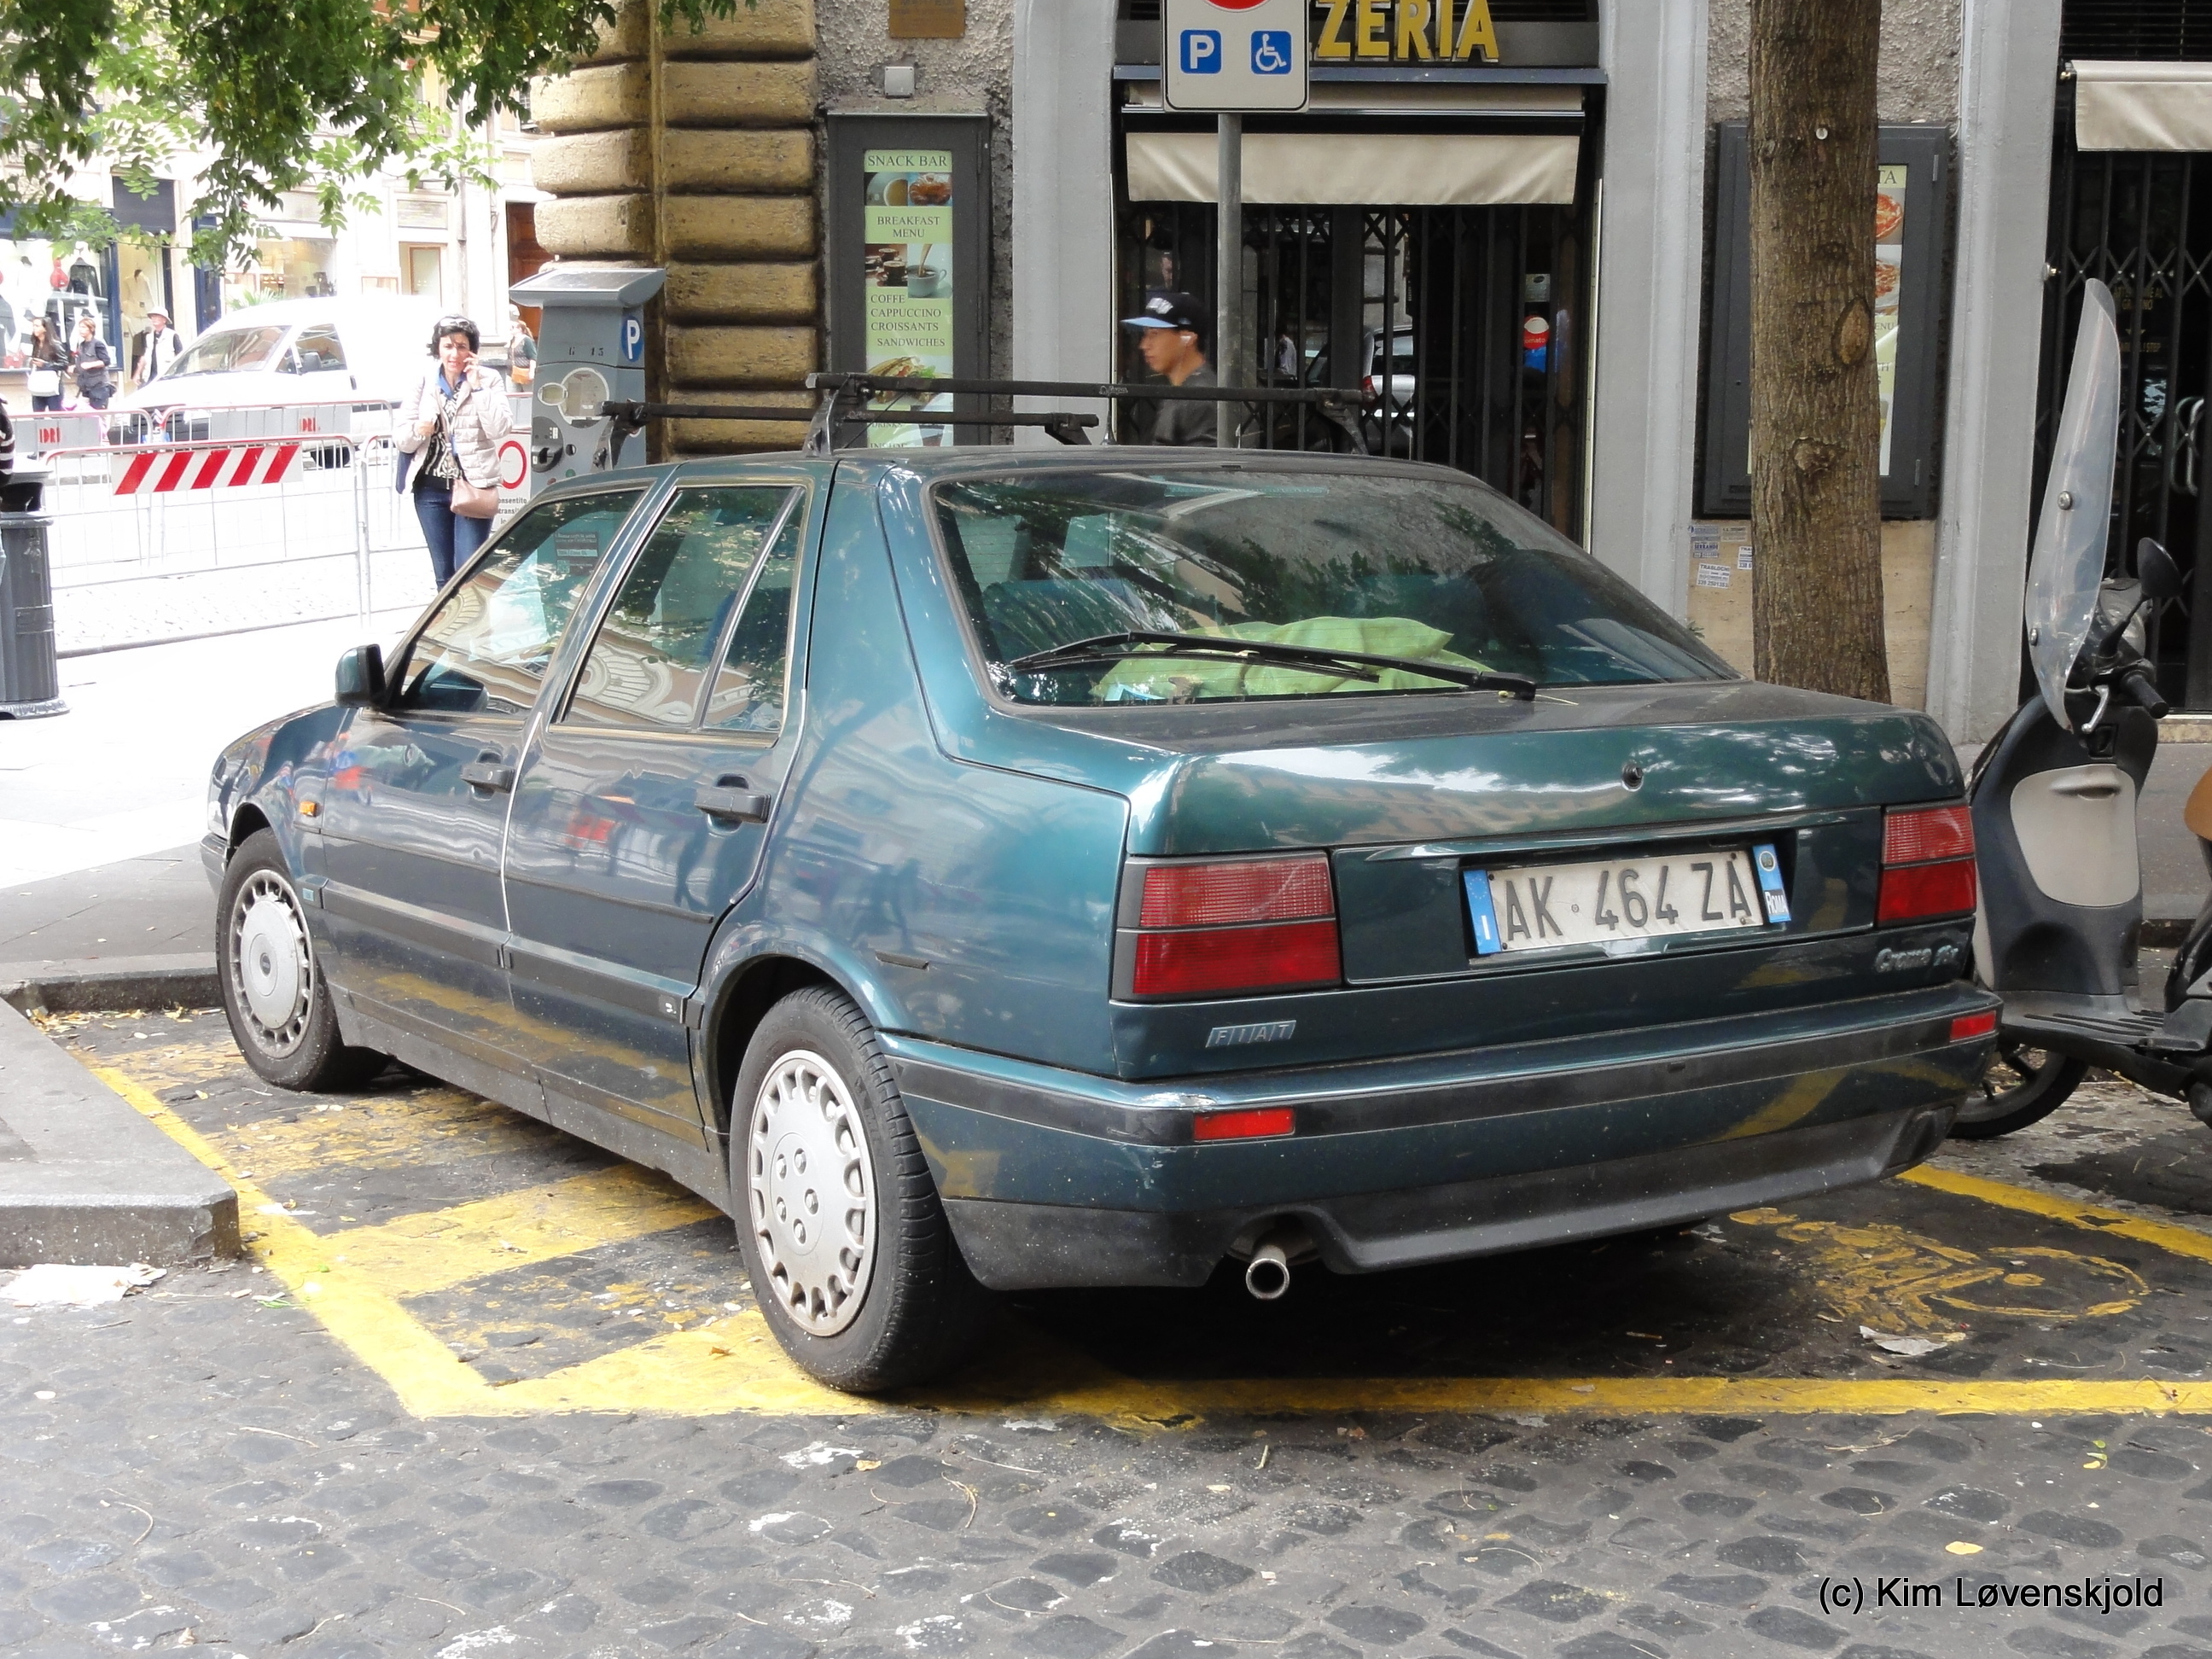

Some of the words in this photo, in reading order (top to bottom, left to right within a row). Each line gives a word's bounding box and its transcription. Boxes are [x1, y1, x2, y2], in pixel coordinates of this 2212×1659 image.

[1315, 0, 1500, 61] ZERIA
[1190, 34, 1215, 69] P
[868, 154, 915, 166] SNACK
[919, 154, 948, 166] BAR
[877, 216, 940, 225] BREAKFAST
[893, 229, 925, 238] MENU
[870, 294, 905, 304] COFFE
[870, 308, 942, 317] CAPPUCCINO
[870, 322, 939, 331] CROISSANTS
[626, 319, 640, 359] P
[876, 338, 946, 346] SANDWICHES
[1505, 876, 1563, 941] AK
[1595, 865, 1679, 930] 464
[1691, 861, 1752, 922] ZA
[1764, 891, 1788, 915] ROMA
[1214, 1024, 1290, 1045] FIAT
